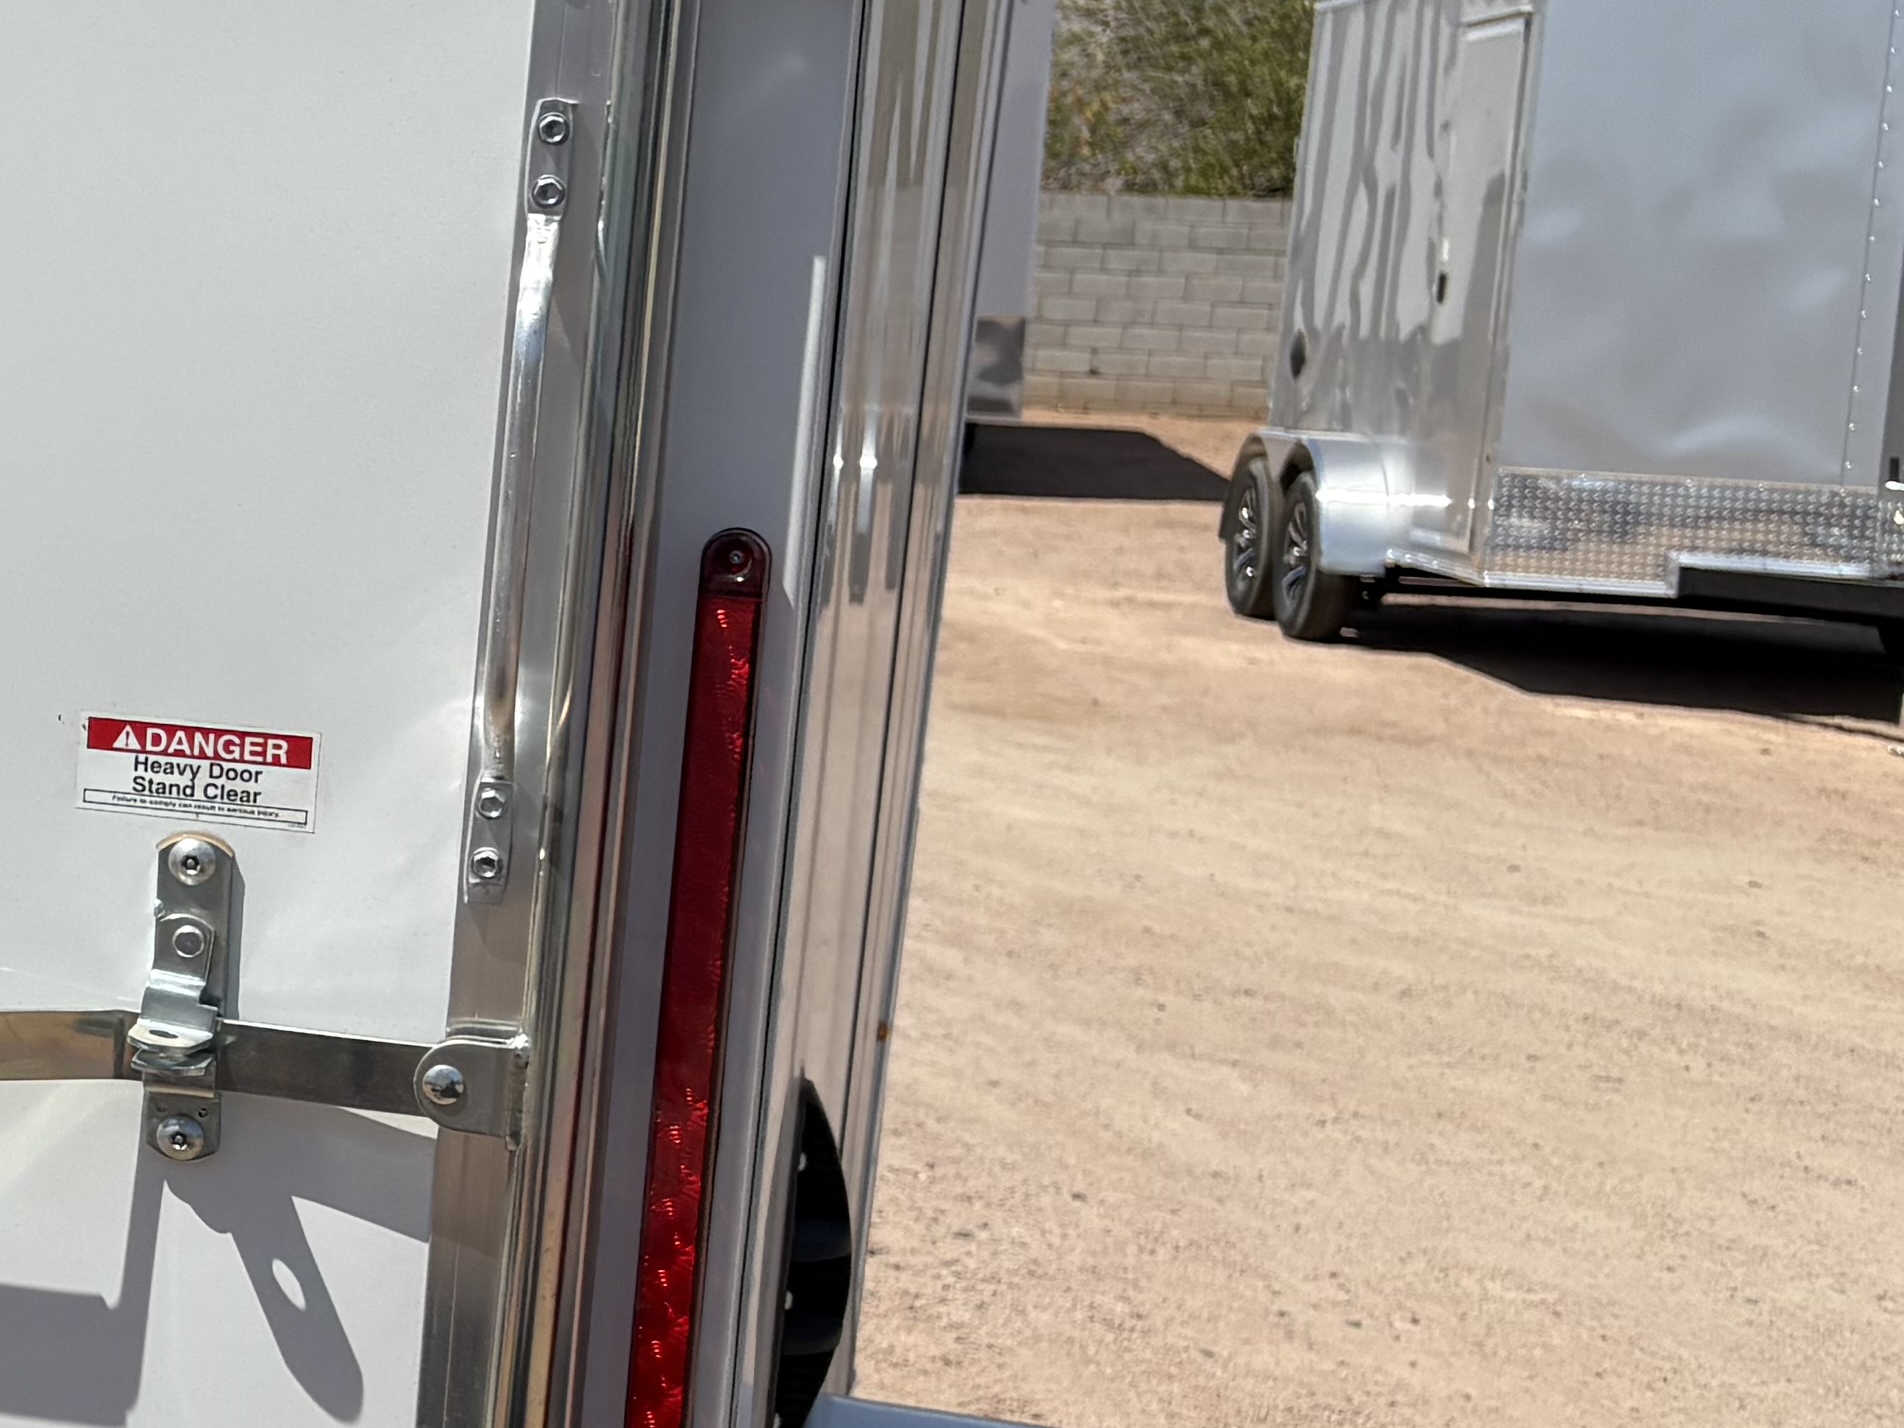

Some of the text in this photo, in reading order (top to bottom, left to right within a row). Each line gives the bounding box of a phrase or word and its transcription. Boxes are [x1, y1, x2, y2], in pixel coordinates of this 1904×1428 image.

[145, 727, 288, 765] DANGER
[134, 755, 263, 784] Heavy Door
[132, 776, 262, 804] Stand Clear
